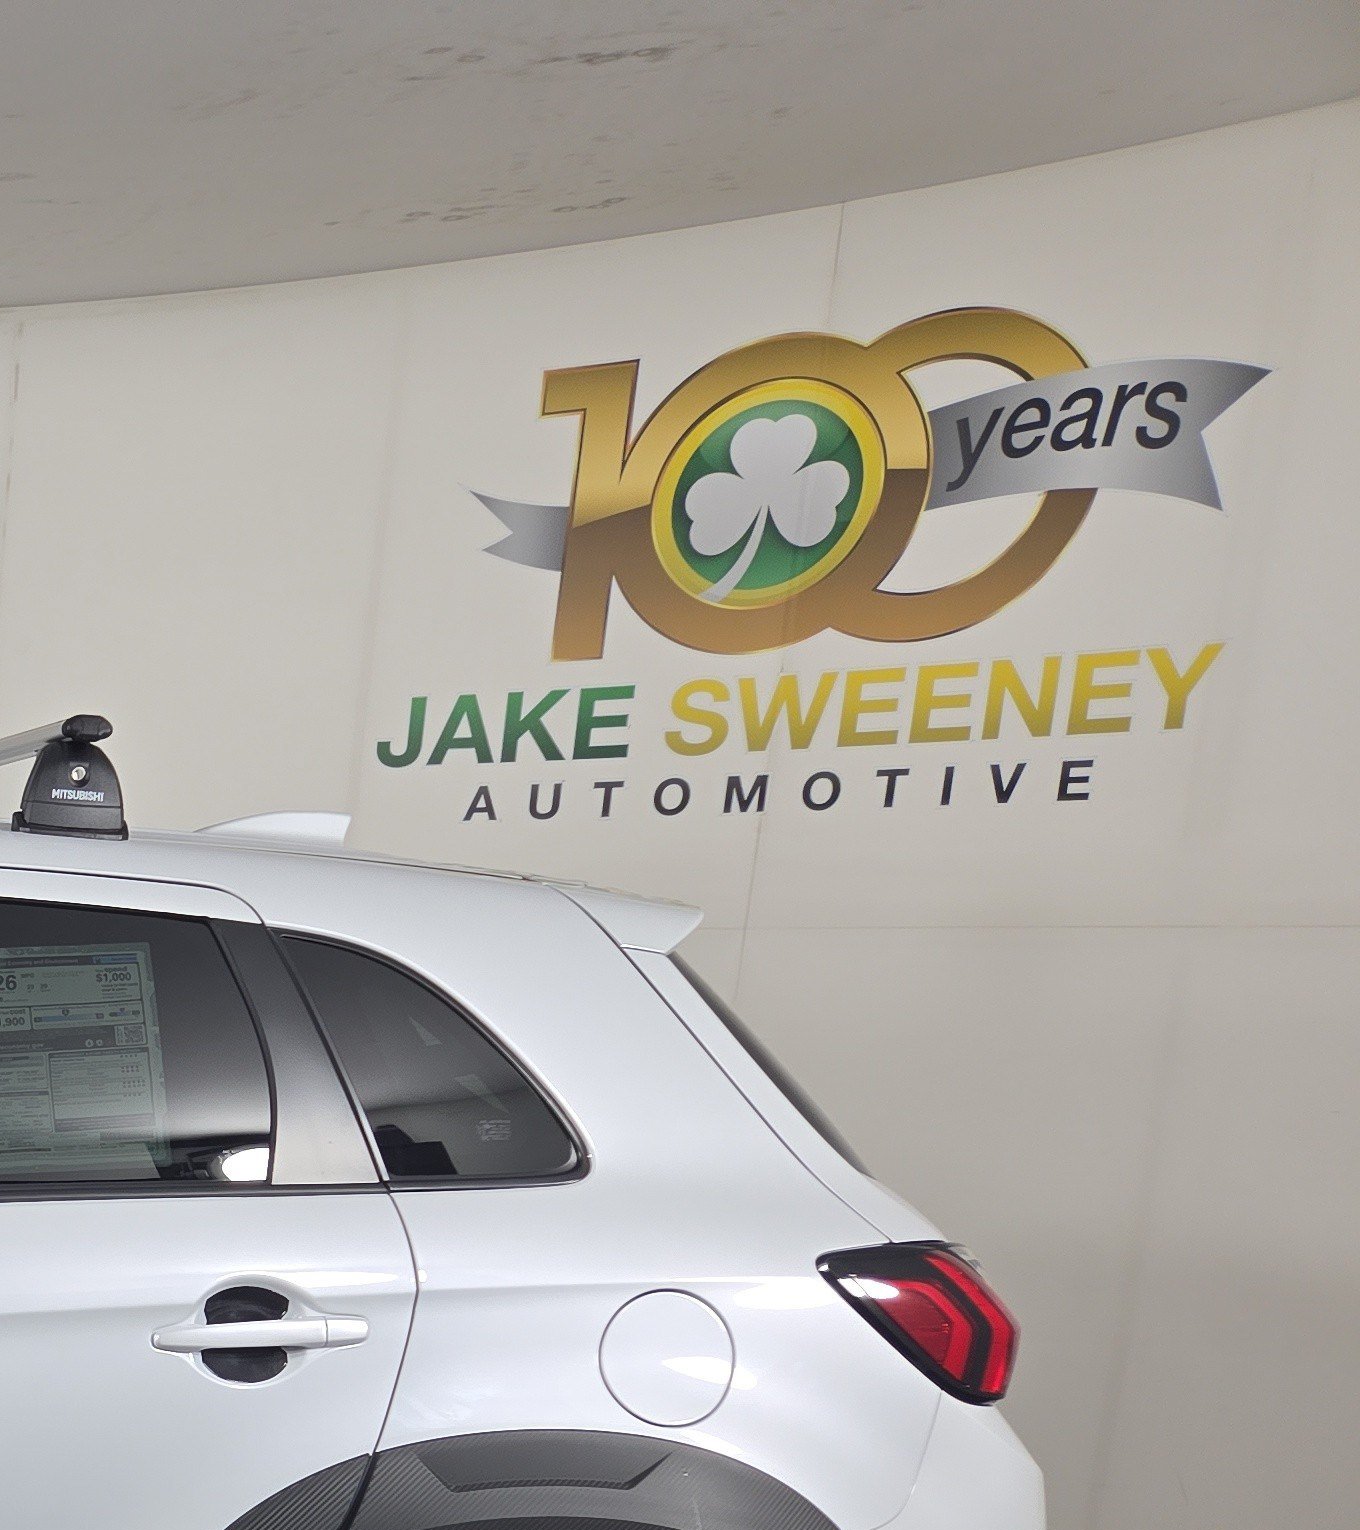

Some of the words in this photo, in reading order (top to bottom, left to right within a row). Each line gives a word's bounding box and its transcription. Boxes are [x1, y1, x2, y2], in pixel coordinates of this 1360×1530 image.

[946, 378, 1188, 492] years
[541, 307, 1097, 660] 100
[376, 685, 636, 768] JAKE
[664, 642, 1224, 757] SWEENEY
[51, 788, 104, 802] MITSUBISHI
[463, 758, 1095, 822] AUTOMOTIVE
[95, 972, 131, 982] $1,000
